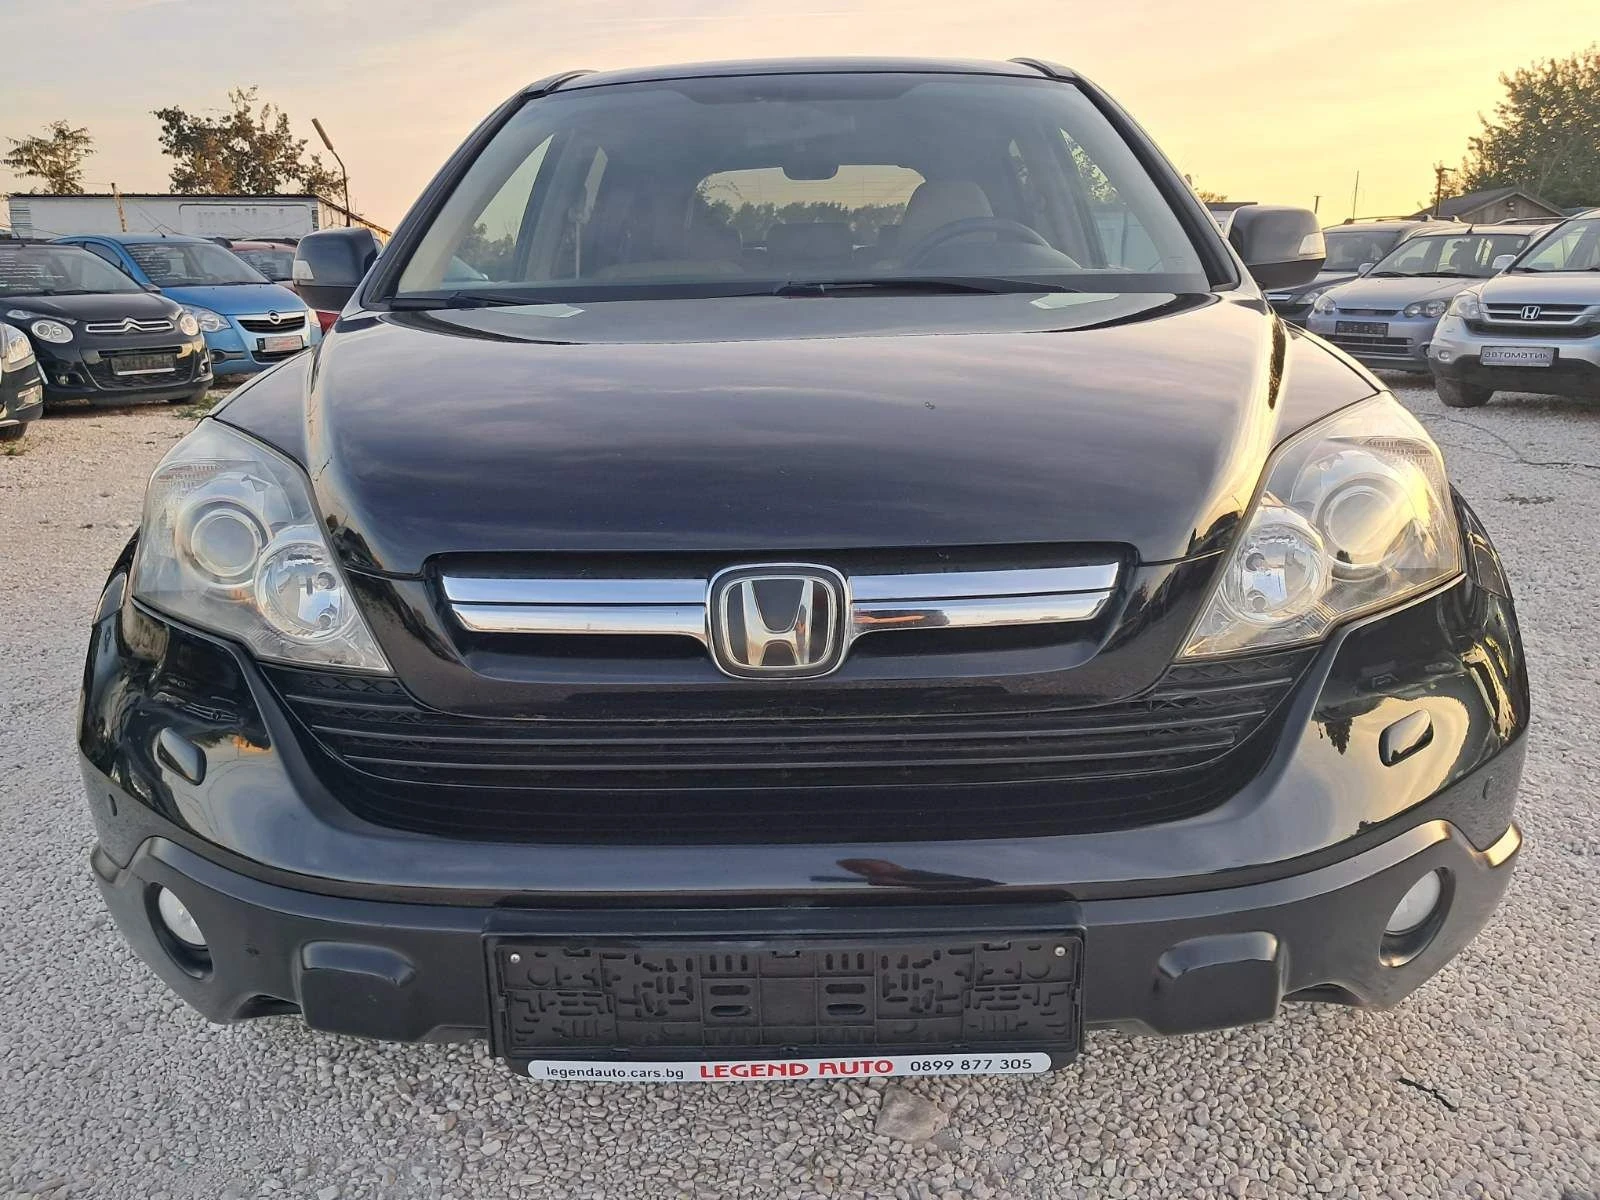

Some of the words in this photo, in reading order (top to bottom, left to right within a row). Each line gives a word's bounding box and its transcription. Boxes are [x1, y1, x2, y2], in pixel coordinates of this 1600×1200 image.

[546, 1066, 684, 1080] legendauto.cars.bg
[700, 1063, 809, 1078] LEGEND
[818, 1060, 894, 1075] AUTO
[910, 1060, 954, 1072] 0899
[960, 1059, 993, 1071] 877
[999, 1058, 1032, 1070] 305
